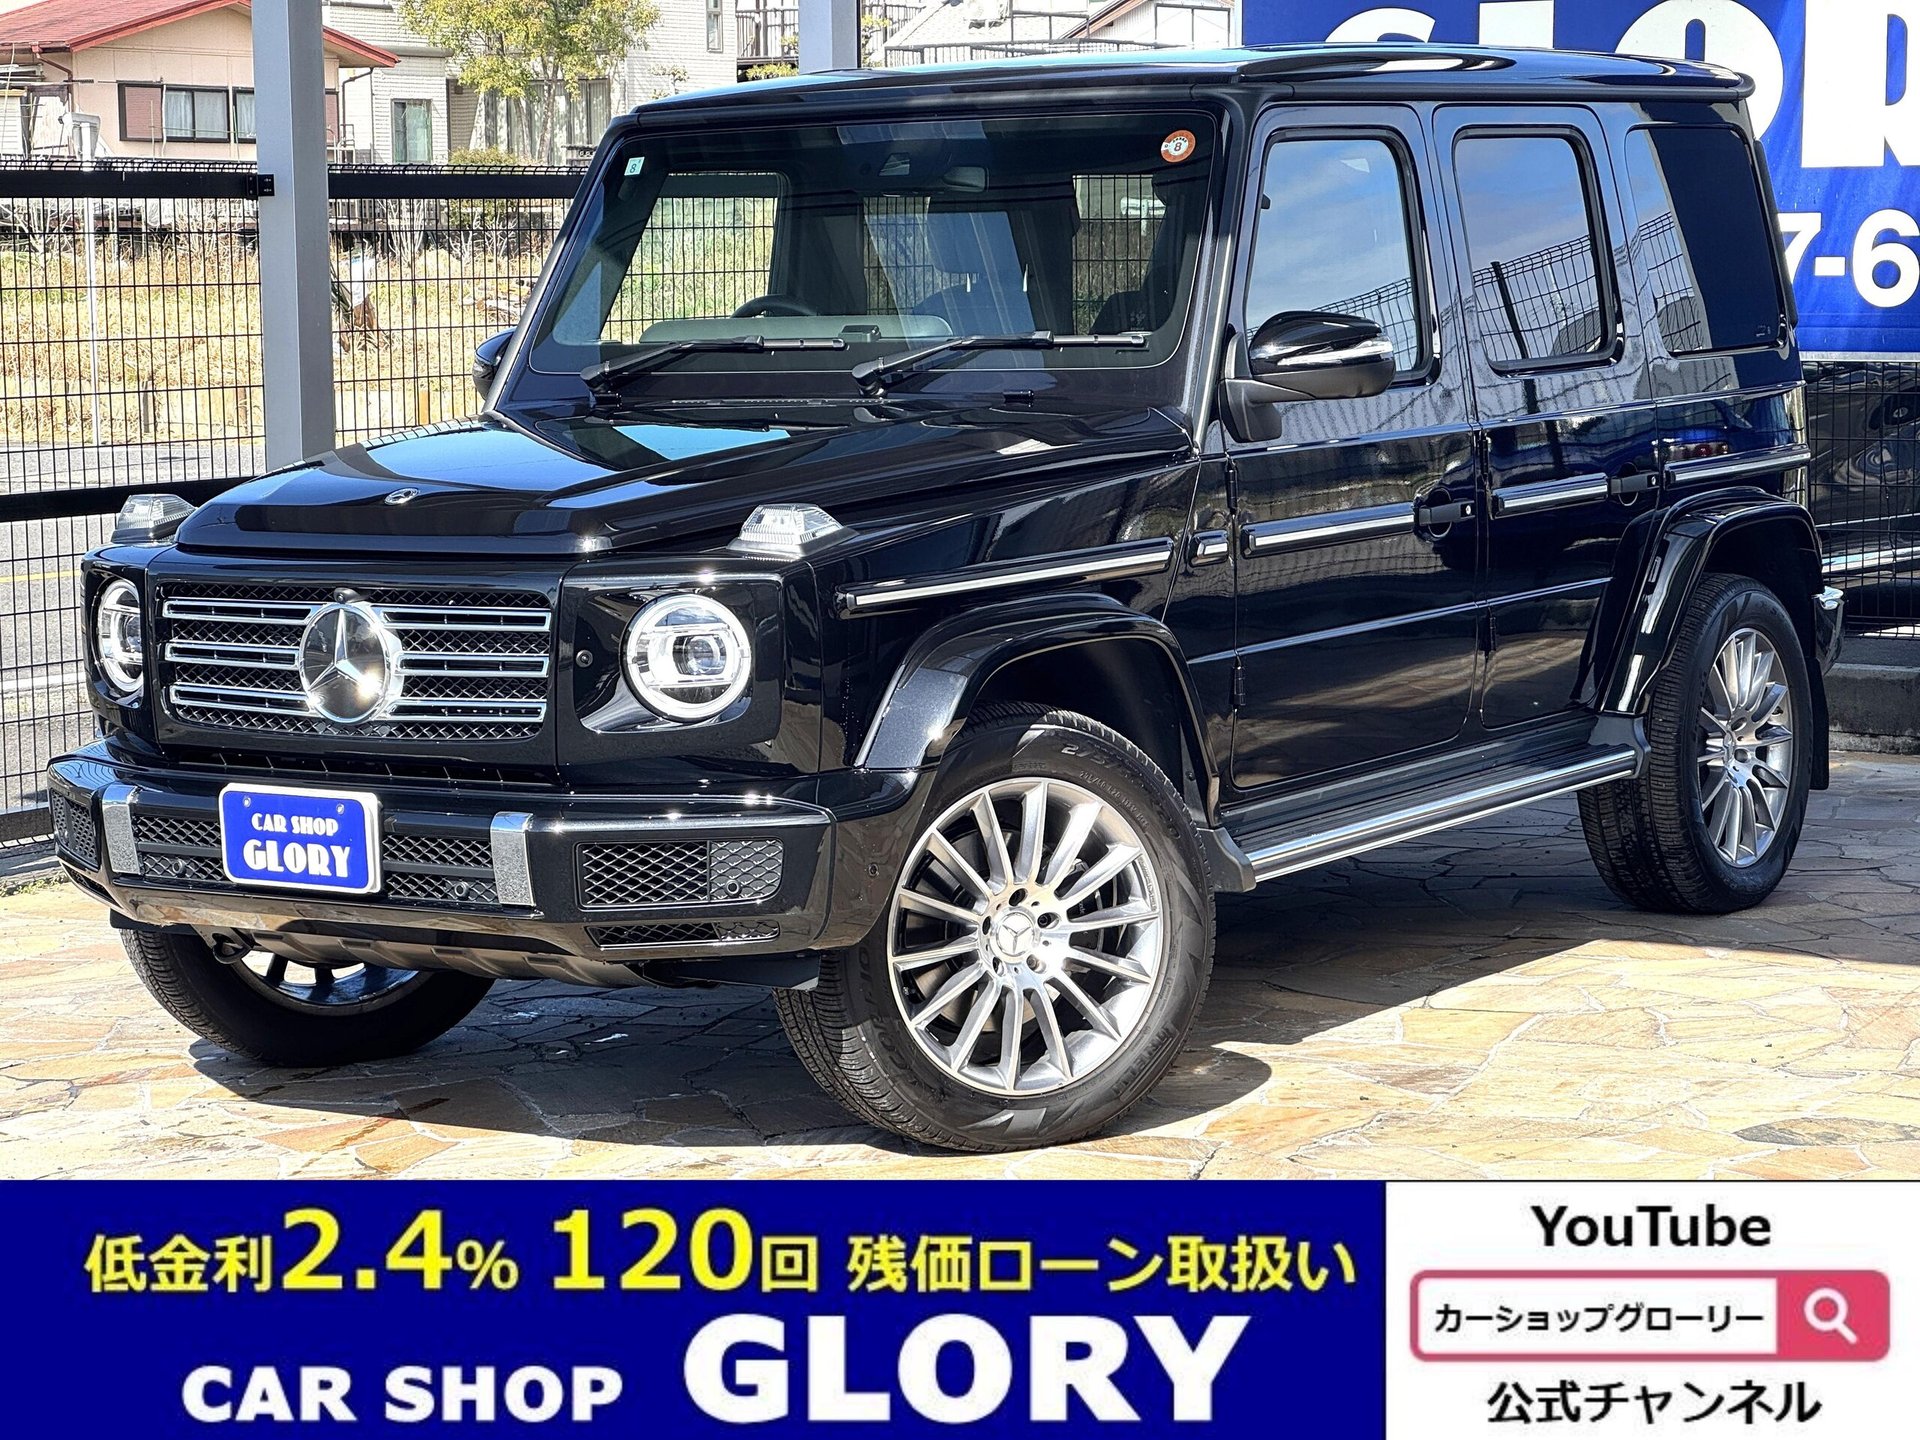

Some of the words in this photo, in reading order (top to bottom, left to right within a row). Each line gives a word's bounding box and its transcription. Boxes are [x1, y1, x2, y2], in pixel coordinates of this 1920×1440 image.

[251, 812, 288, 833] CAR
[290, 815, 339, 837] SHOP
[243, 838, 351, 878] GLORY
